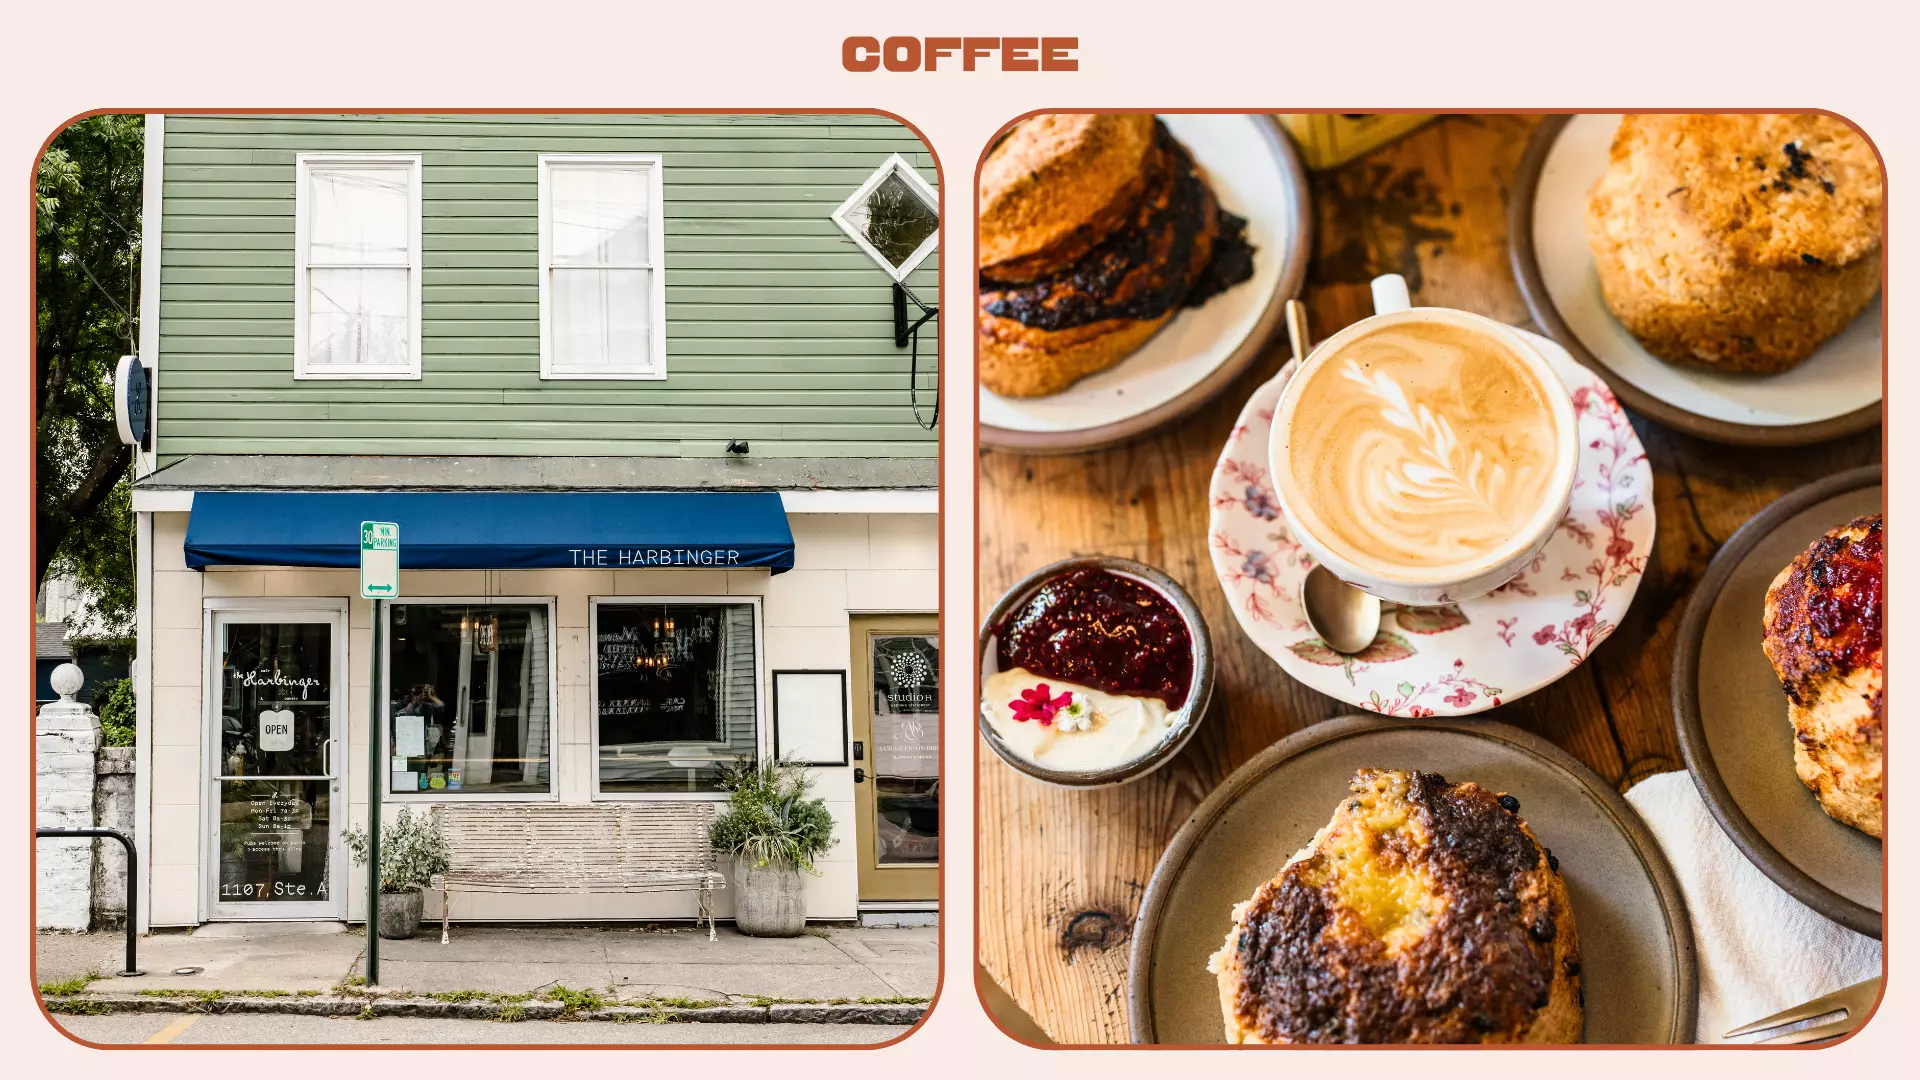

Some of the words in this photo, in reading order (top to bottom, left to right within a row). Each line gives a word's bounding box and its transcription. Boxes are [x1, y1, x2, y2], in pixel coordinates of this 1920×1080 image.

[364, 530, 373, 544] 30
[374, 538, 396, 547] PARKING
[569, 549, 607, 565] THE
[619, 549, 739, 565] HARBINGER
[243, 669, 320, 700] Harbinger
[265, 725, 288, 734] OPEN
